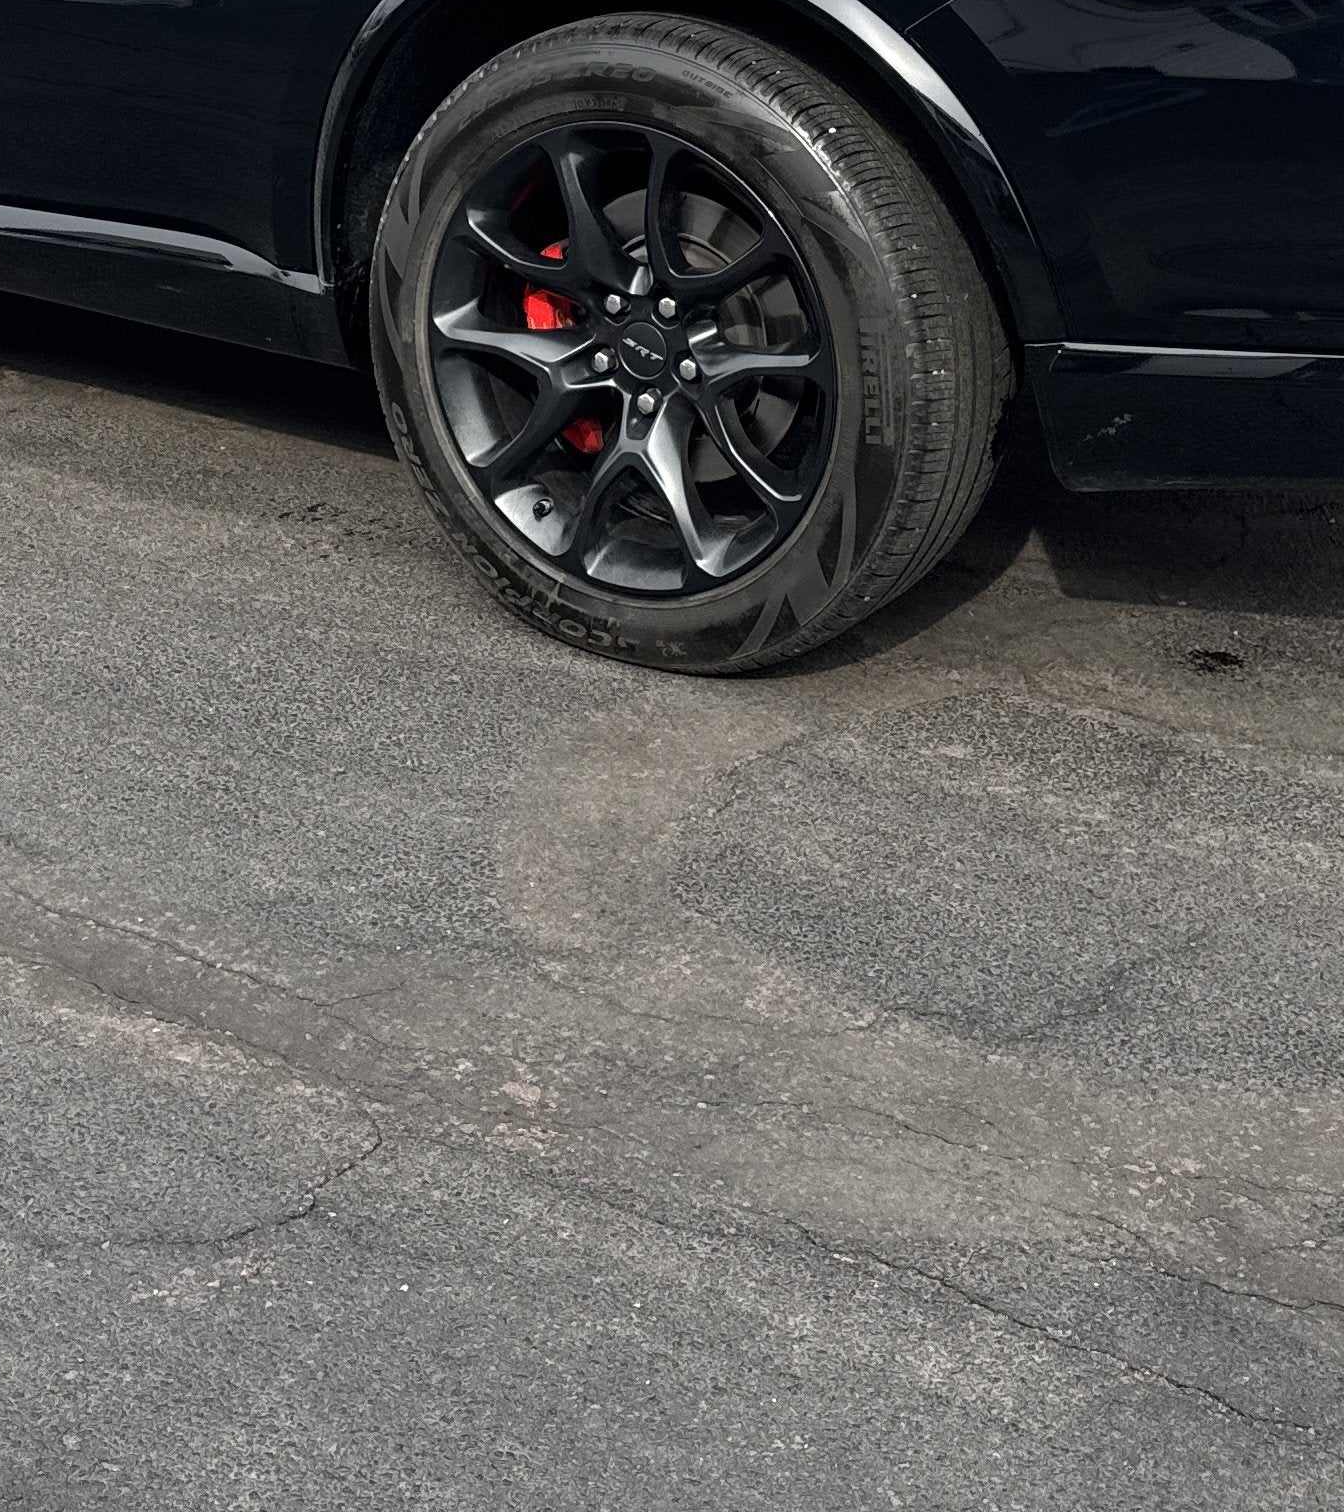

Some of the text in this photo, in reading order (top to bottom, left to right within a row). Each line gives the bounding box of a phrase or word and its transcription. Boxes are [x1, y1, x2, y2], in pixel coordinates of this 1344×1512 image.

[681, 69, 734, 99] OUTSIDE
[622, 337, 664, 361] SRT
[858, 318, 894, 447] PIRELLI
